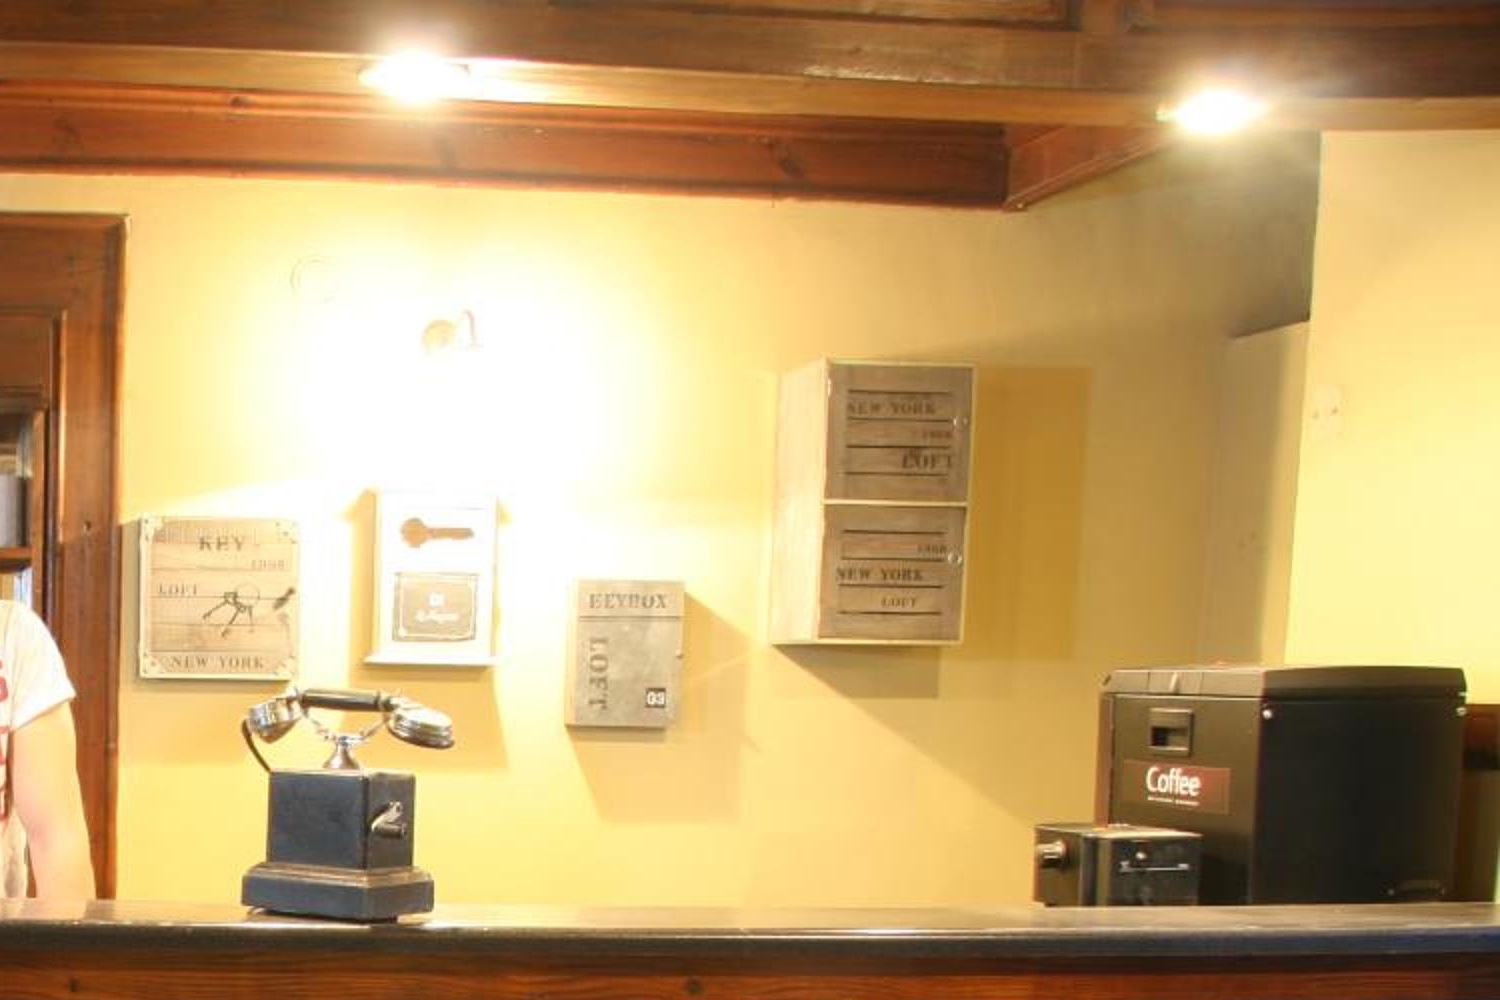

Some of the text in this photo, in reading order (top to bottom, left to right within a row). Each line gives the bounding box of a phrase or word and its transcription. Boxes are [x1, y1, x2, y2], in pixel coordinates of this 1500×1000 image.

[199, 534, 244, 551] KEY
[588, 637, 609, 711] LOFT
[1146, 766, 1202, 796] Coffee
